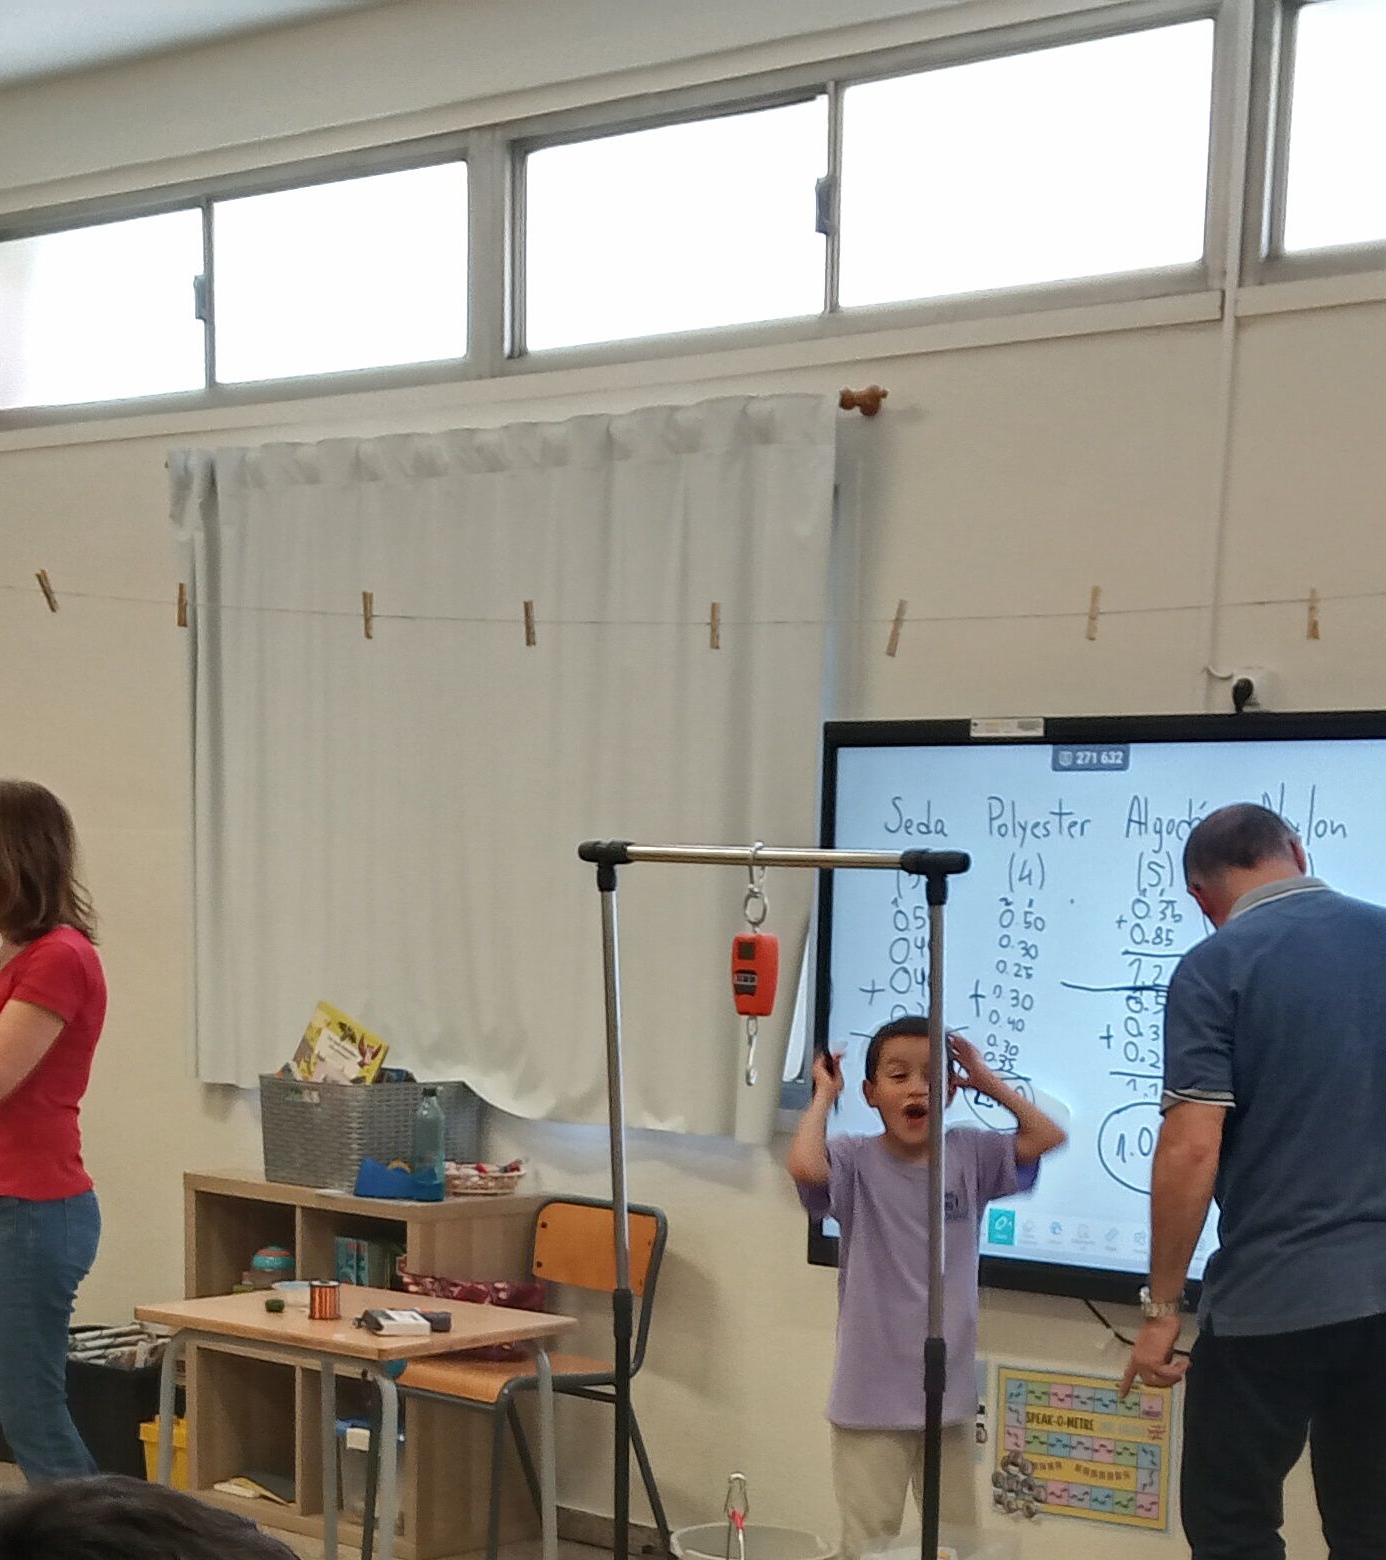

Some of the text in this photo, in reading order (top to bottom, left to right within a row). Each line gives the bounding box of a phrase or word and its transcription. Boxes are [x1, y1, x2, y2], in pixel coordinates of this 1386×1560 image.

[1075, 751, 1125, 765] 271 632
[884, 796, 949, 838] Seda
[986, 795, 1092, 849] Polyester
[1125, 795, 1207, 854] Algod
[1008, 851, 1045, 893] (4)
[999, 909, 1046, 932] 0.50
[999, 934, 1038, 960] 0.30
[1130, 922, 1175, 947] 0.85
